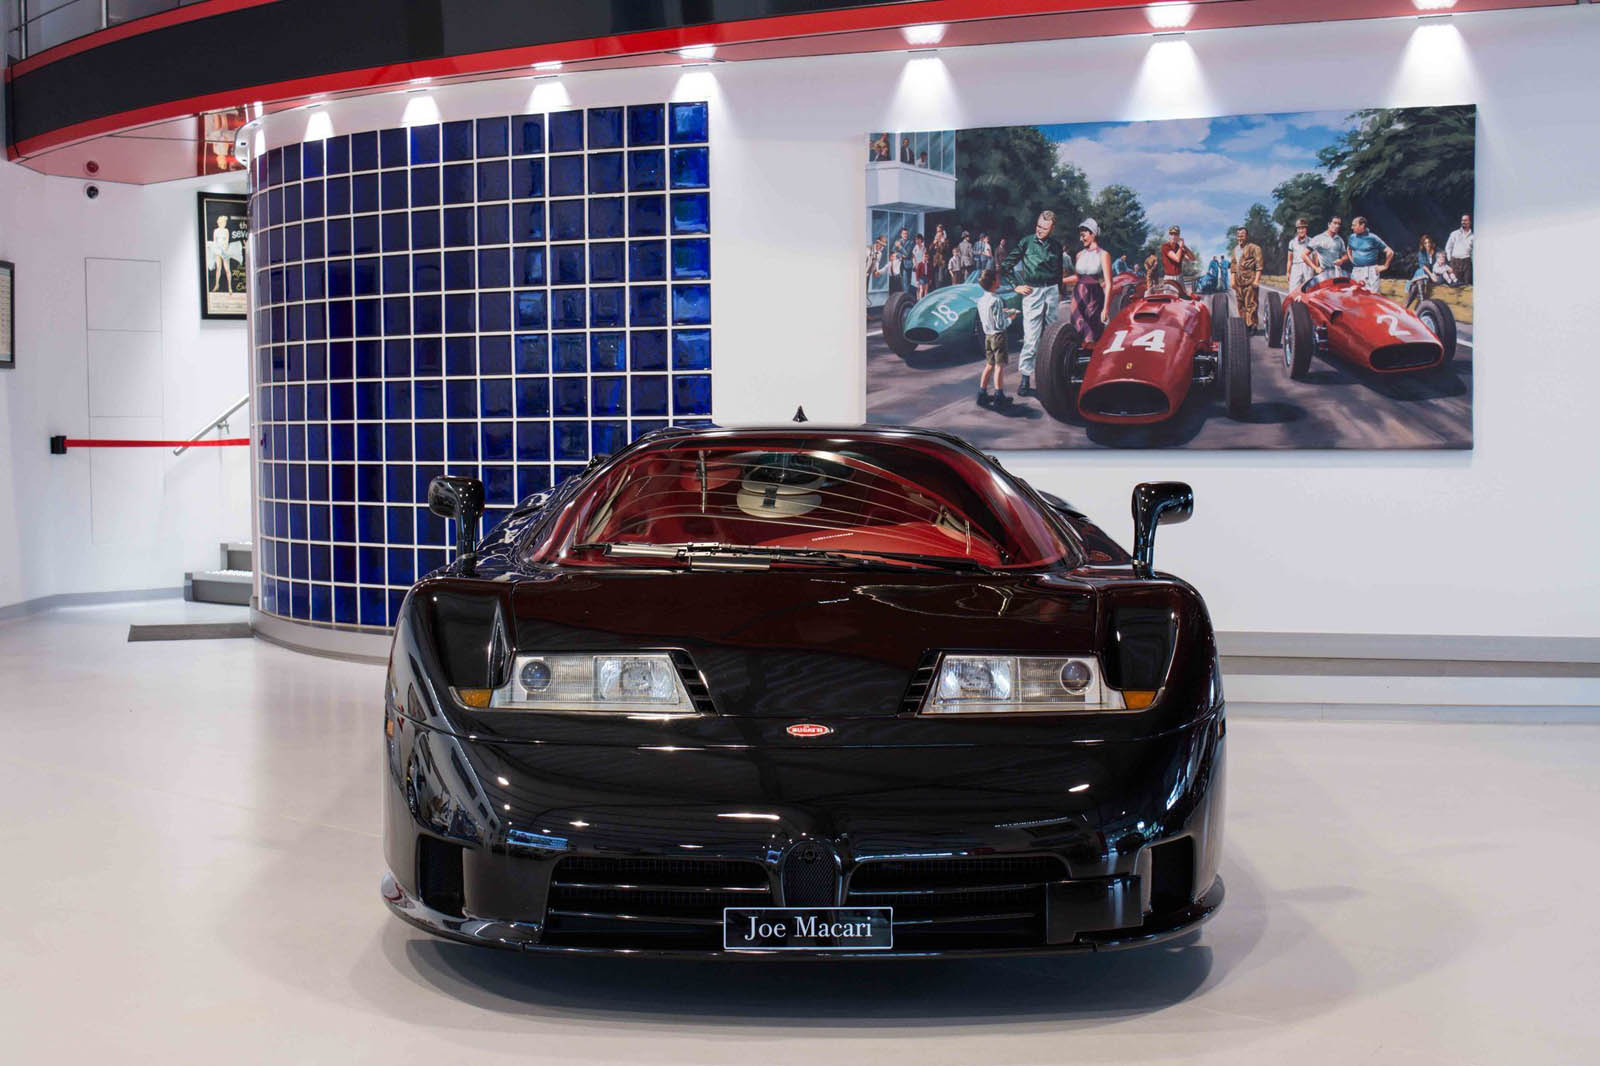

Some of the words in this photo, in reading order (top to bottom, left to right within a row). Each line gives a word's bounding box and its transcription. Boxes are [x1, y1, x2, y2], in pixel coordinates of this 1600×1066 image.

[931, 304, 959, 325] 18
[1376, 314, 1412, 336] 2
[1102, 329, 1166, 355] 14
[744, 915, 786, 941] Joe
[793, 915, 873, 938] Macari
